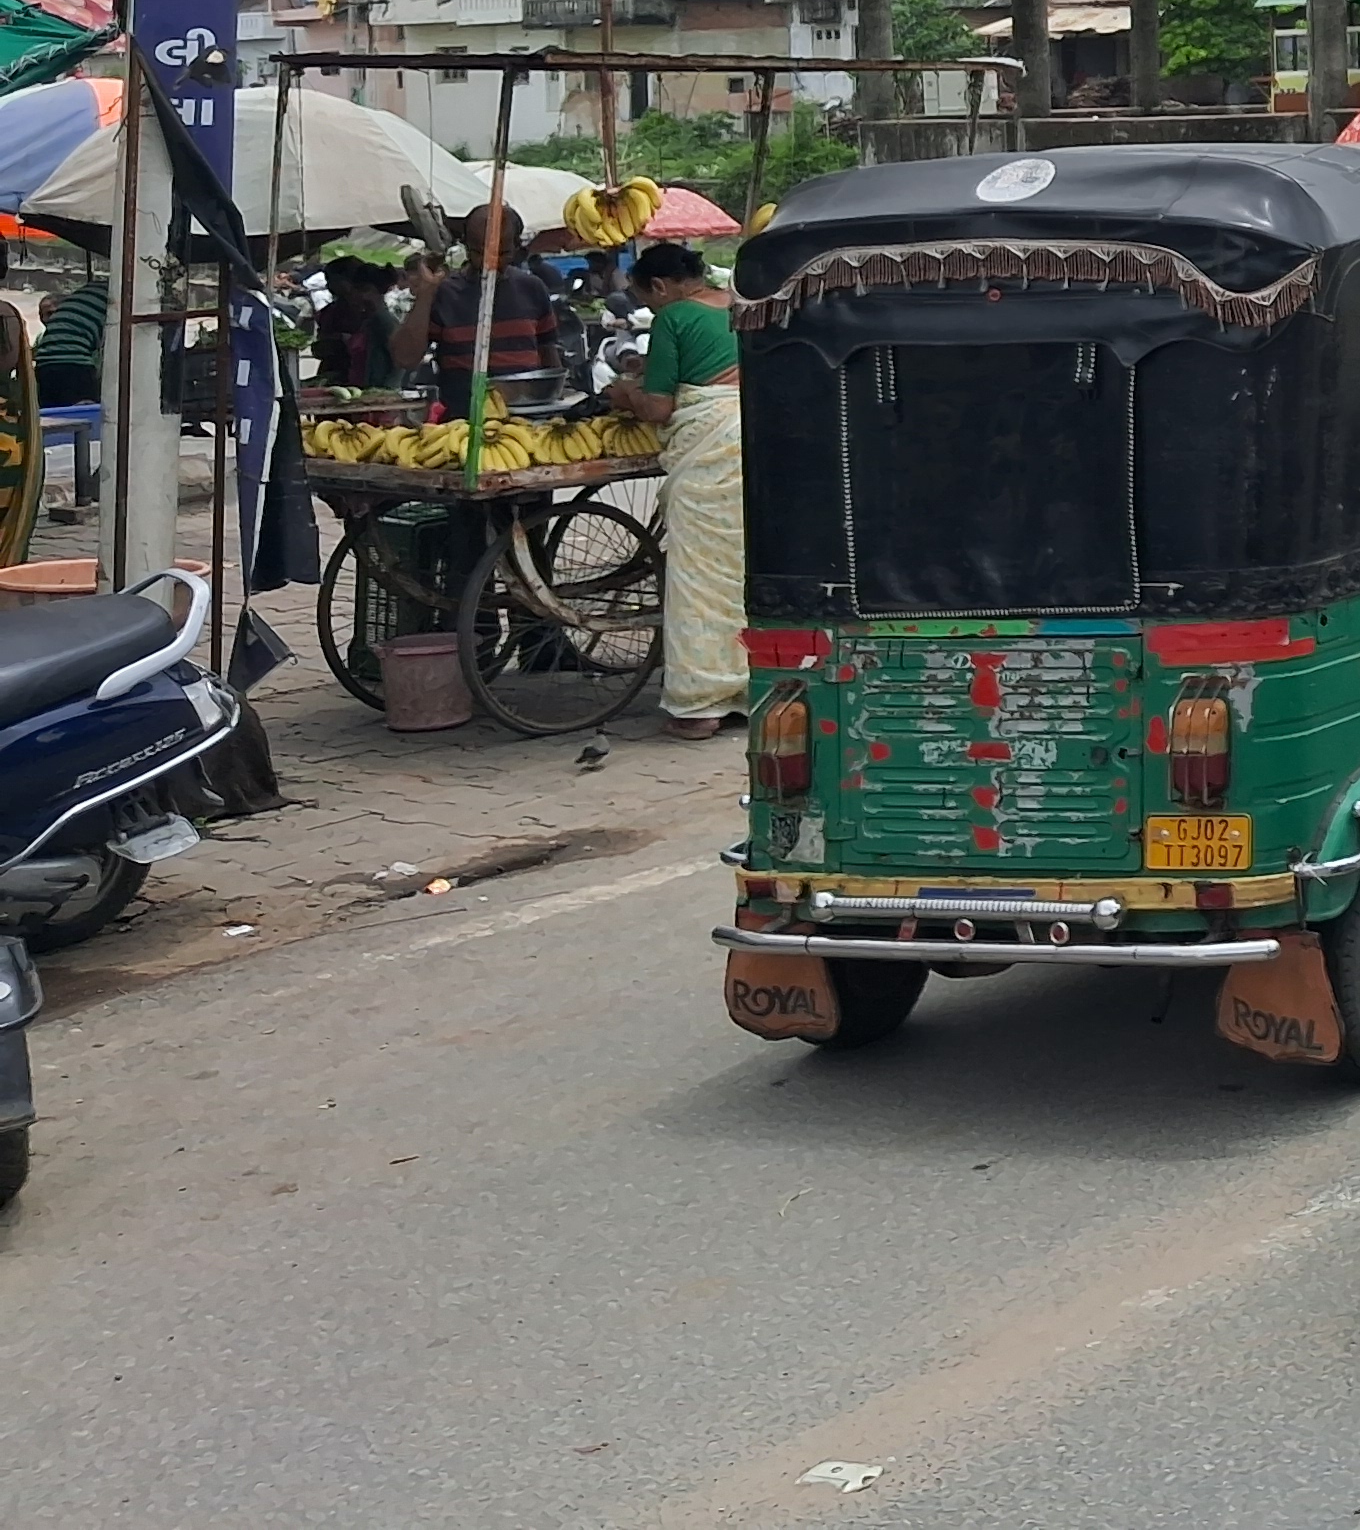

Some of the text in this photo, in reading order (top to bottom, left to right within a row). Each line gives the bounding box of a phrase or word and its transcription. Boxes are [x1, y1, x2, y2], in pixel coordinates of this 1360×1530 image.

[1177, 819, 1229, 841] GJ02
[1164, 844, 1243, 867] TT3097
[733, 978, 826, 1019] ROYAL
[1232, 996, 1324, 1051] ROYAL
